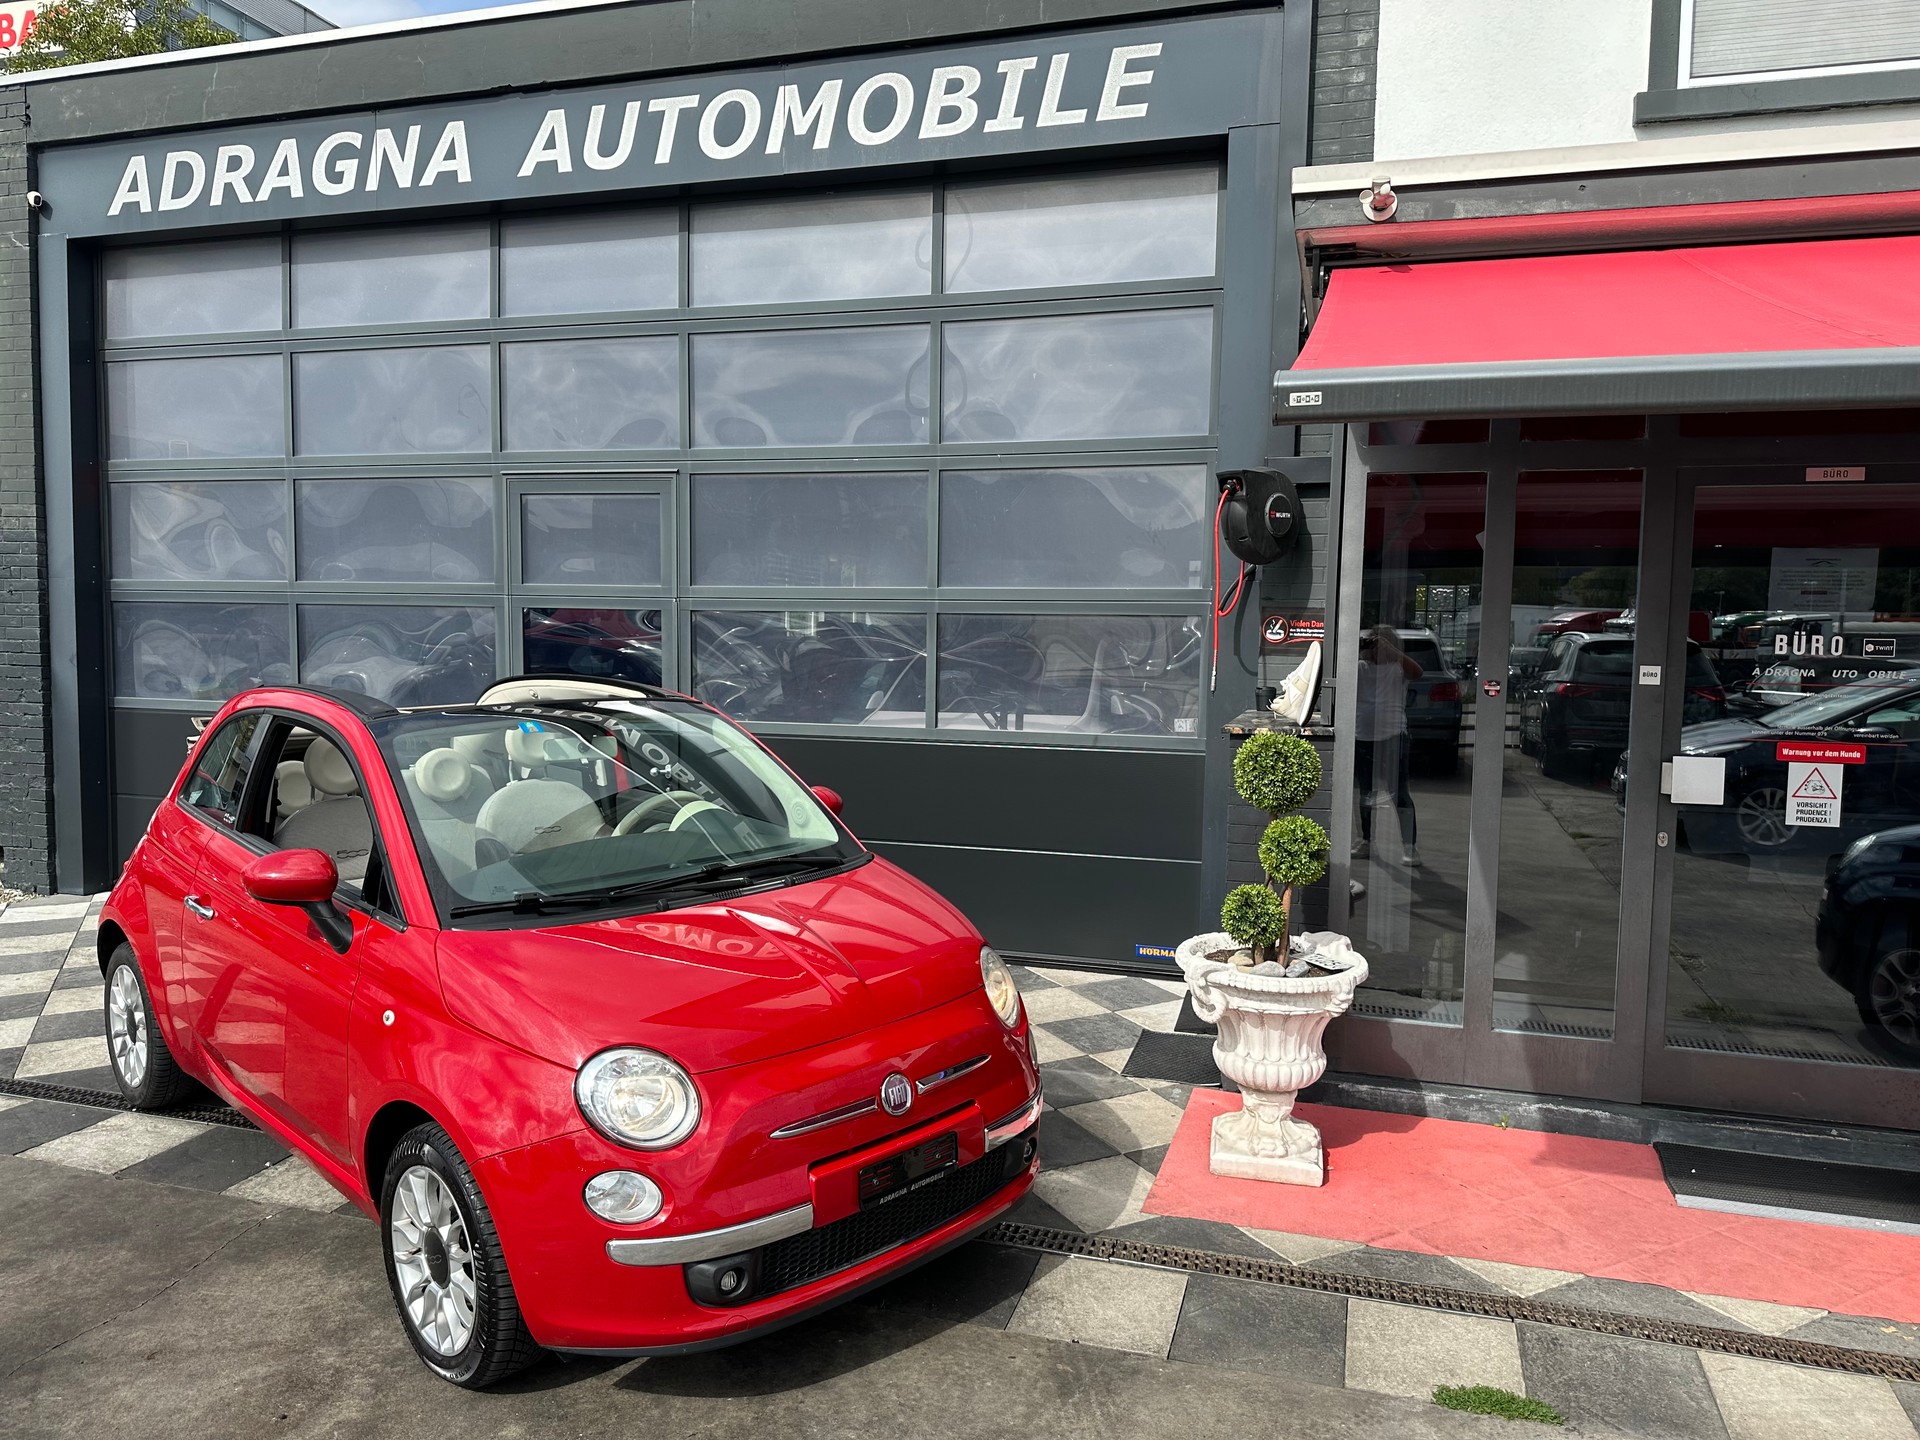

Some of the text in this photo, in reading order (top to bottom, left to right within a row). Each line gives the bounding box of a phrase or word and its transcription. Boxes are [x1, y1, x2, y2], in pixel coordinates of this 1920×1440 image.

[107, 41, 1163, 217] ADRAGNA AUTOMOBILE
[1823, 468, 1849, 478] BÜRO
[1290, 619, 1325, 628] Vielen Dan
[1774, 631, 1844, 656] BÜRO
[1642, 670, 1658, 678] BÜRO
[1782, 748, 1811, 757] Warnung
[1840, 750, 1861, 759] Hunde
[1796, 801, 1828, 809] VORSICHT
[1795, 809, 1828, 817] PRUDENCE
[1795, 816, 1828, 824] PRUDENZA
[336, 848, 369, 859] 500
[1139, 947, 1176, 957] HÖRMA
[888, 1083, 907, 1106] FIAT
[879, 1171, 945, 1205] ADRAGNA AUTOMOBILE
